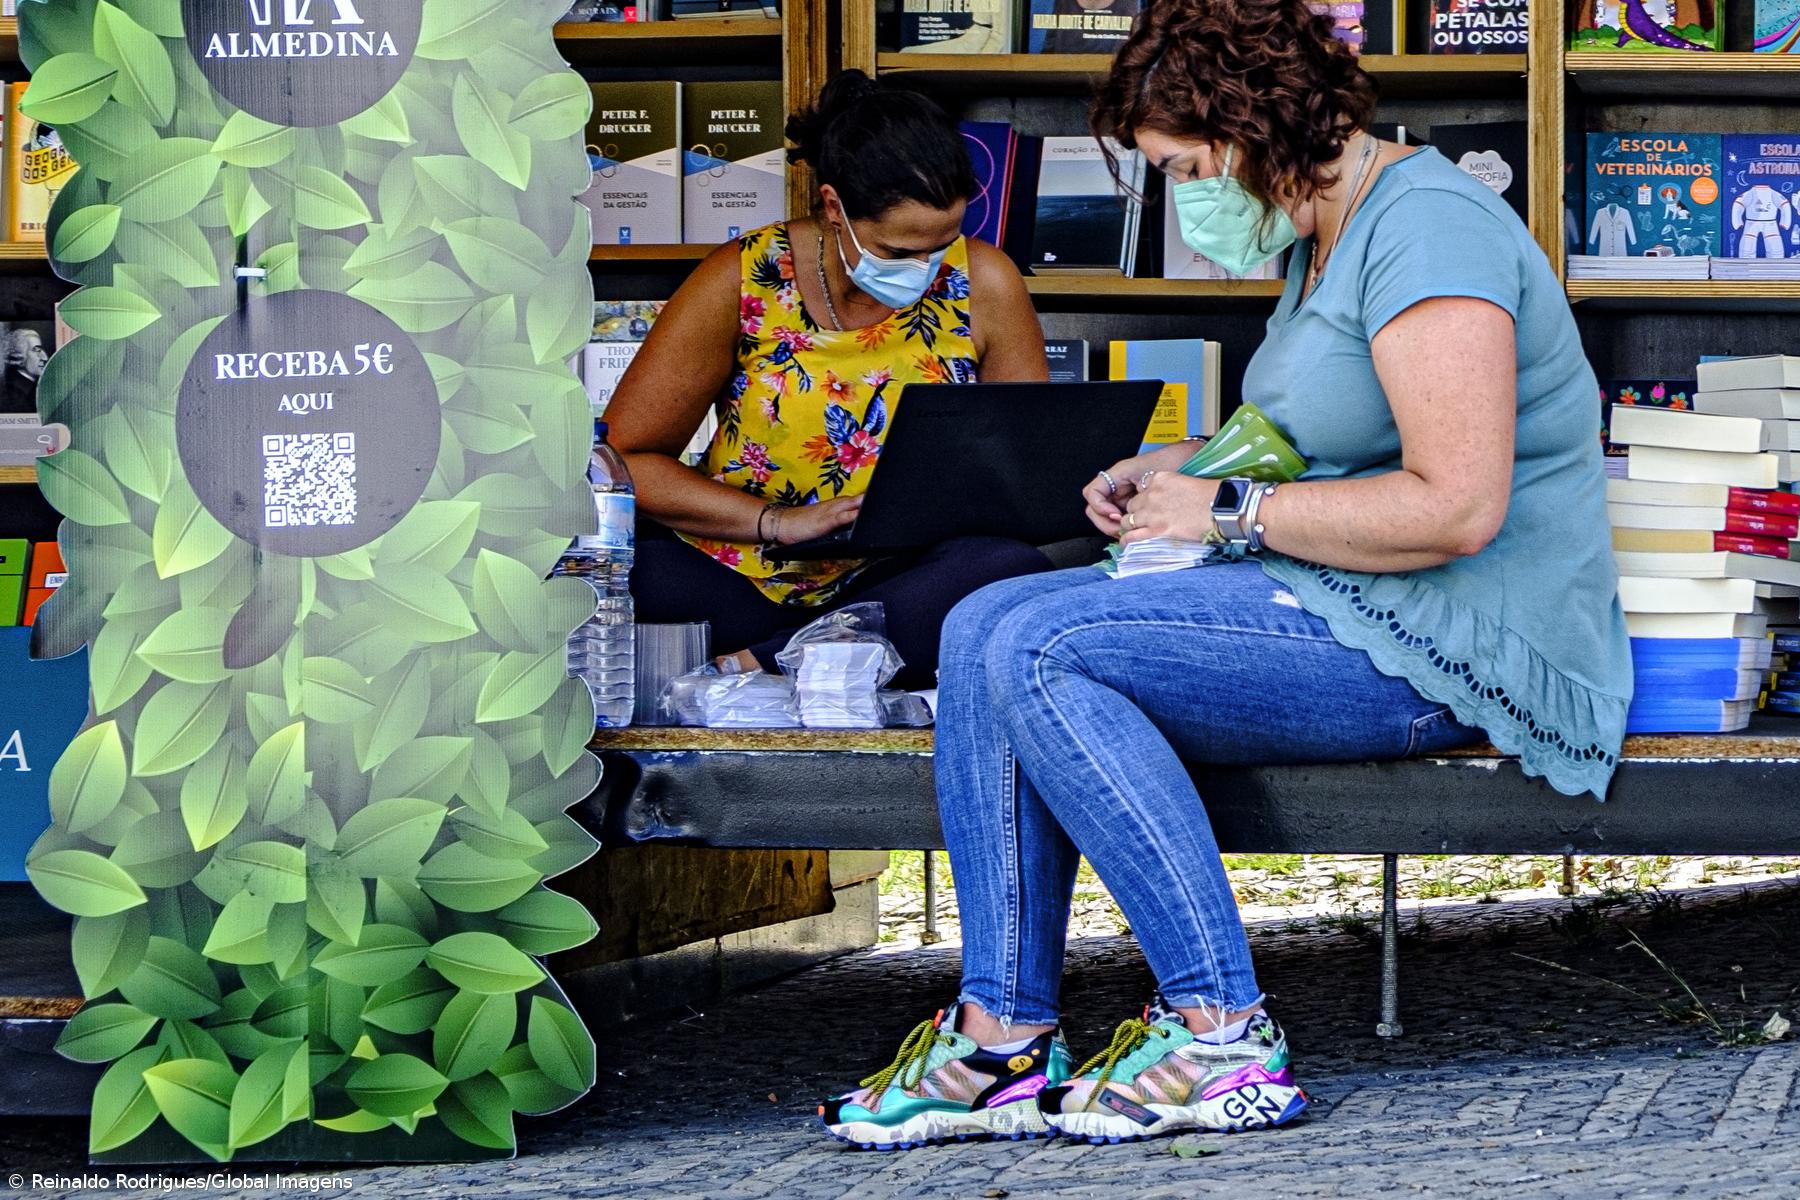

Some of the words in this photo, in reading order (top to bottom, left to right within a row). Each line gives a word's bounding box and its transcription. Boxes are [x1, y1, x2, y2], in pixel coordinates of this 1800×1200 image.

[1434, 9, 1529, 29] PÉTALAS
[1434, 30, 1463, 46] OU
[1471, 30, 1529, 45] OSSOS
[205, 31, 399, 59] ALMEDINA
[602, 110, 637, 120] PETER
[711, 109, 747, 120] PETER
[599, 123, 652, 134] DRUCKER
[708, 123, 761, 133] DRUCKER
[1620, 139, 1688, 153] ESCOLA
[1646, 153, 1662, 162] DE
[1469, 161, 1494, 172] MINI
[1595, 160, 1713, 176] VETERINÁRIOS
[711, 191, 758, 200] ESSENCIAIS
[215, 351, 350, 381] RECEBA
[354, 342, 394, 375] 5€
[277, 392, 334, 415] AQUI
